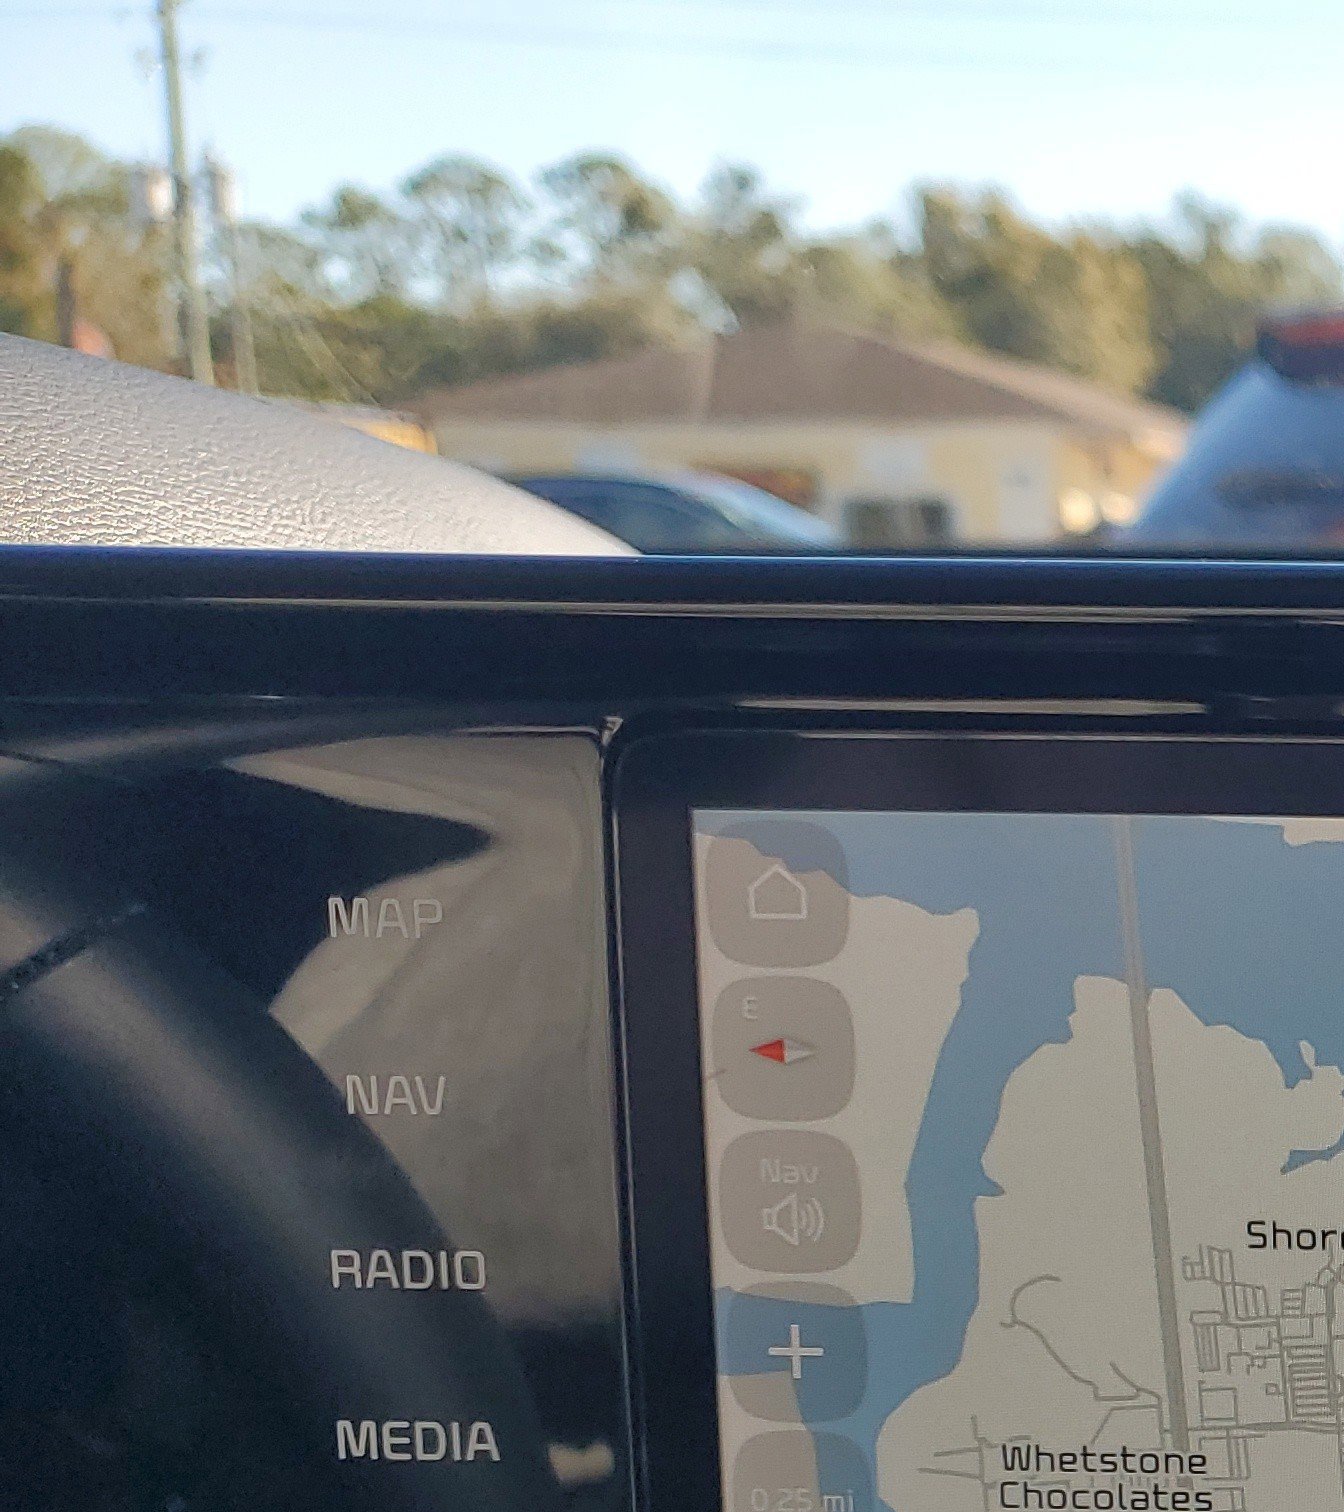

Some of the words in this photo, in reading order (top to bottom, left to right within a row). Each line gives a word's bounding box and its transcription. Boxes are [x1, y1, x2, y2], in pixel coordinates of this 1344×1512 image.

[327, 896, 443, 940] MAP
[742, 997, 758, 1019] E
[345, 1073, 447, 1116] NAV
[761, 1159, 818, 1184] Nav
[330, 1248, 487, 1292] RADIO
[337, 1420, 501, 1463] MEDIA
[1001, 1443, 1207, 1477] Whetstone
[823, 1489, 854, 1512] mi
[1000, 1481, 1213, 1512] Chocolates
